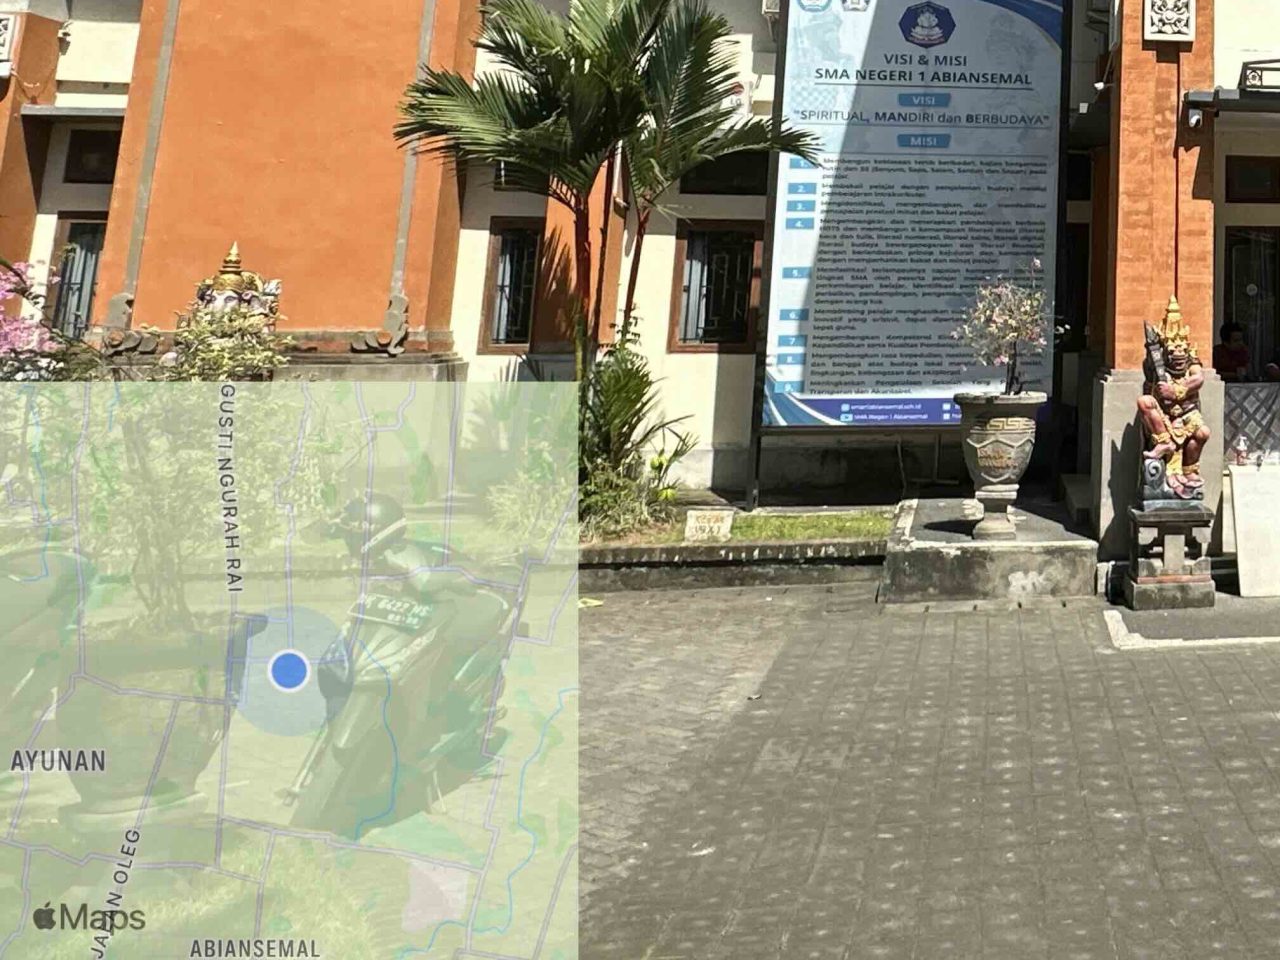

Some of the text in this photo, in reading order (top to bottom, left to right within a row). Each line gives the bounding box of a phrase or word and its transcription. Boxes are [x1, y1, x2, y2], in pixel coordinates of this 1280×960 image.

[884, 53, 967, 67] VISI & MISI
[815, 68, 1033, 85] SMA NEGERI 1 ABIANSEMAL
[912, 96, 936, 106] VISI
[874, 111, 934, 123] MANDIRI
[938, 111, 962, 123] dan
[965, 113, 1049, 125] BERBUDAYA"
[910, 136, 938, 146] MISI
